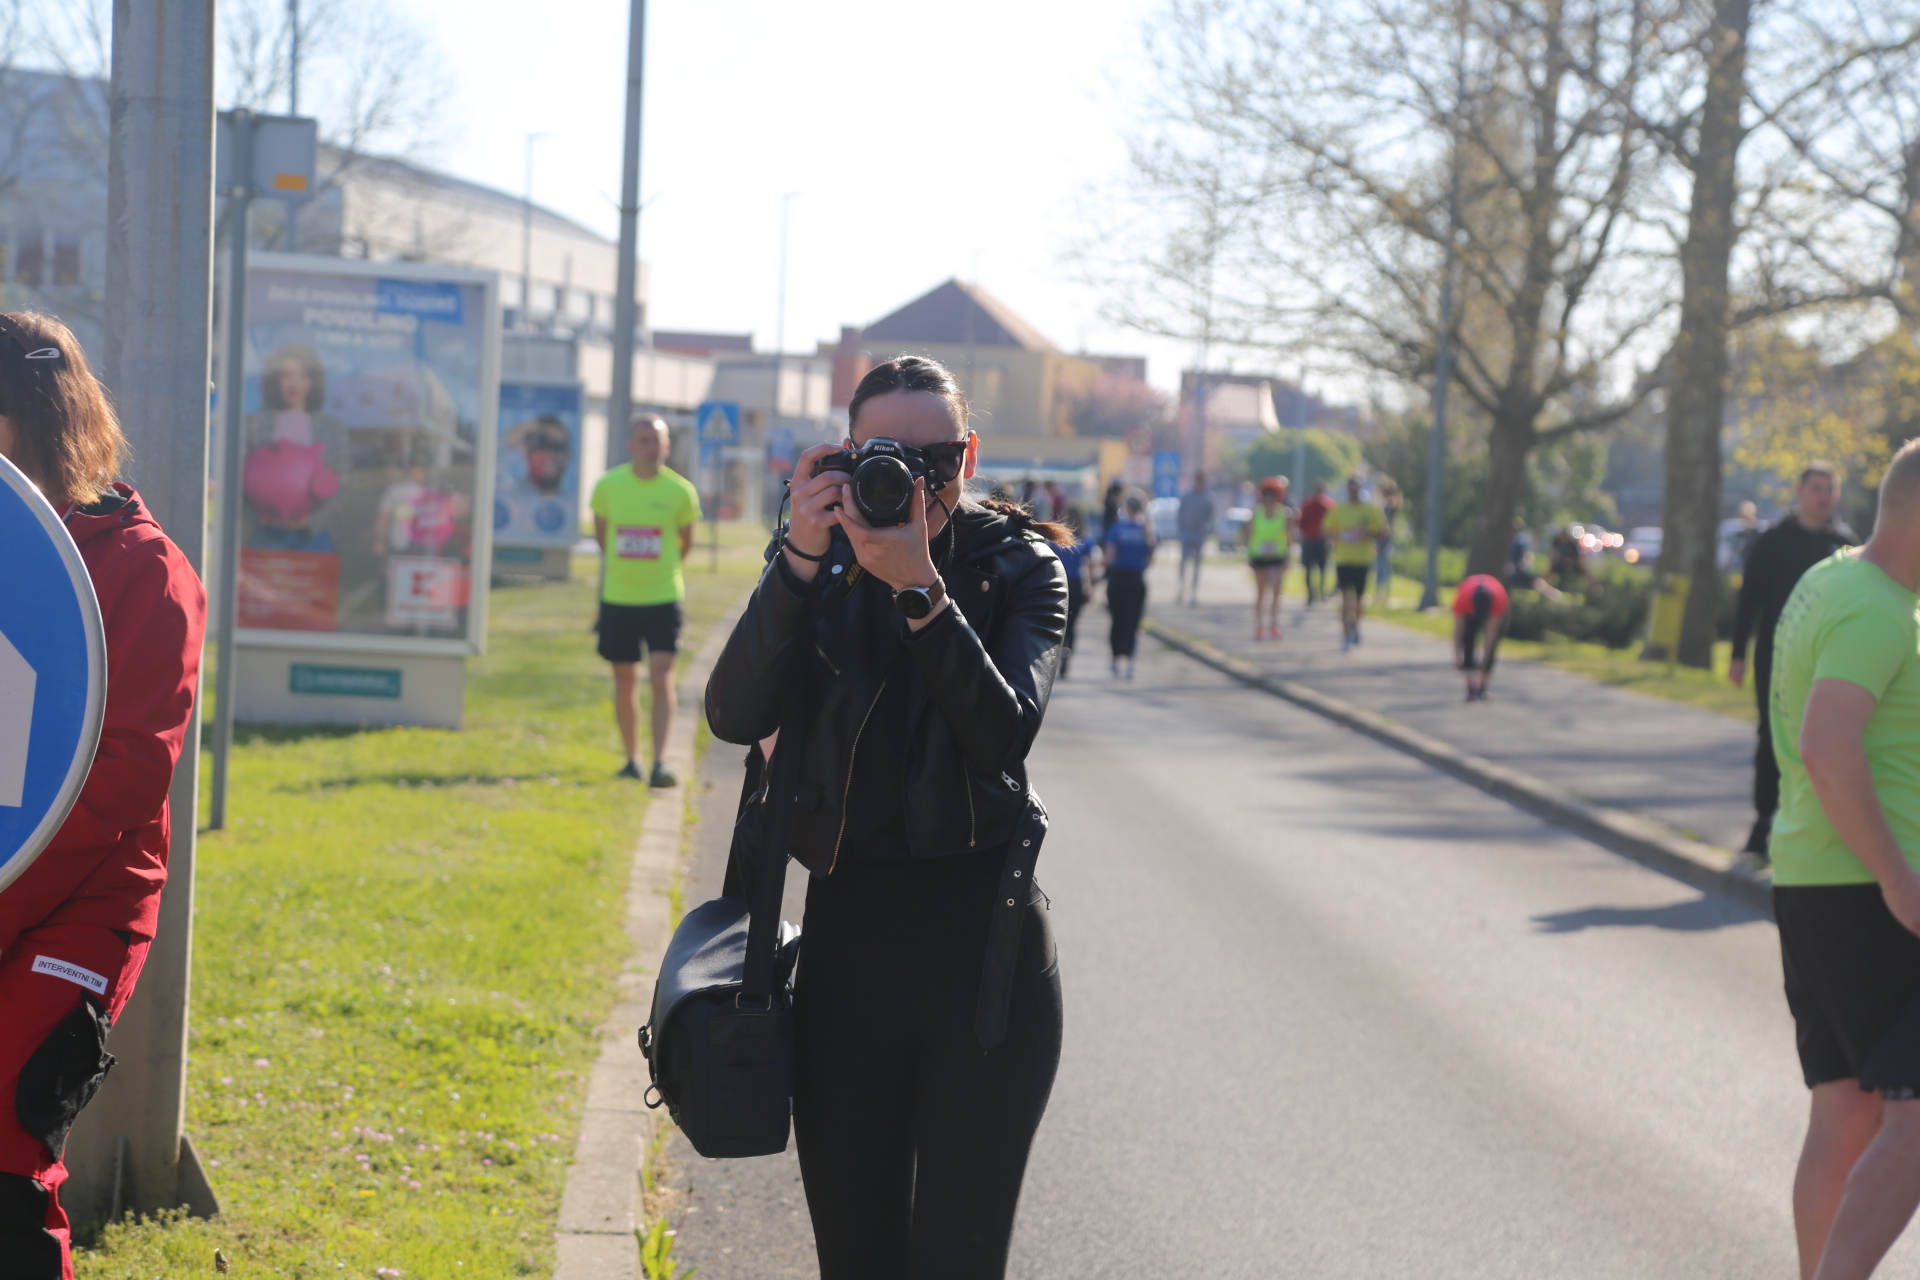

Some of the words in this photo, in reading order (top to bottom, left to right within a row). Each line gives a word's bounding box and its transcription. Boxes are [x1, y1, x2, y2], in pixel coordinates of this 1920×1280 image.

[873, 444, 895, 452] Nikon
[38, 960, 90, 982] INTERVENTNI
[90, 977, 103, 988] TIM
